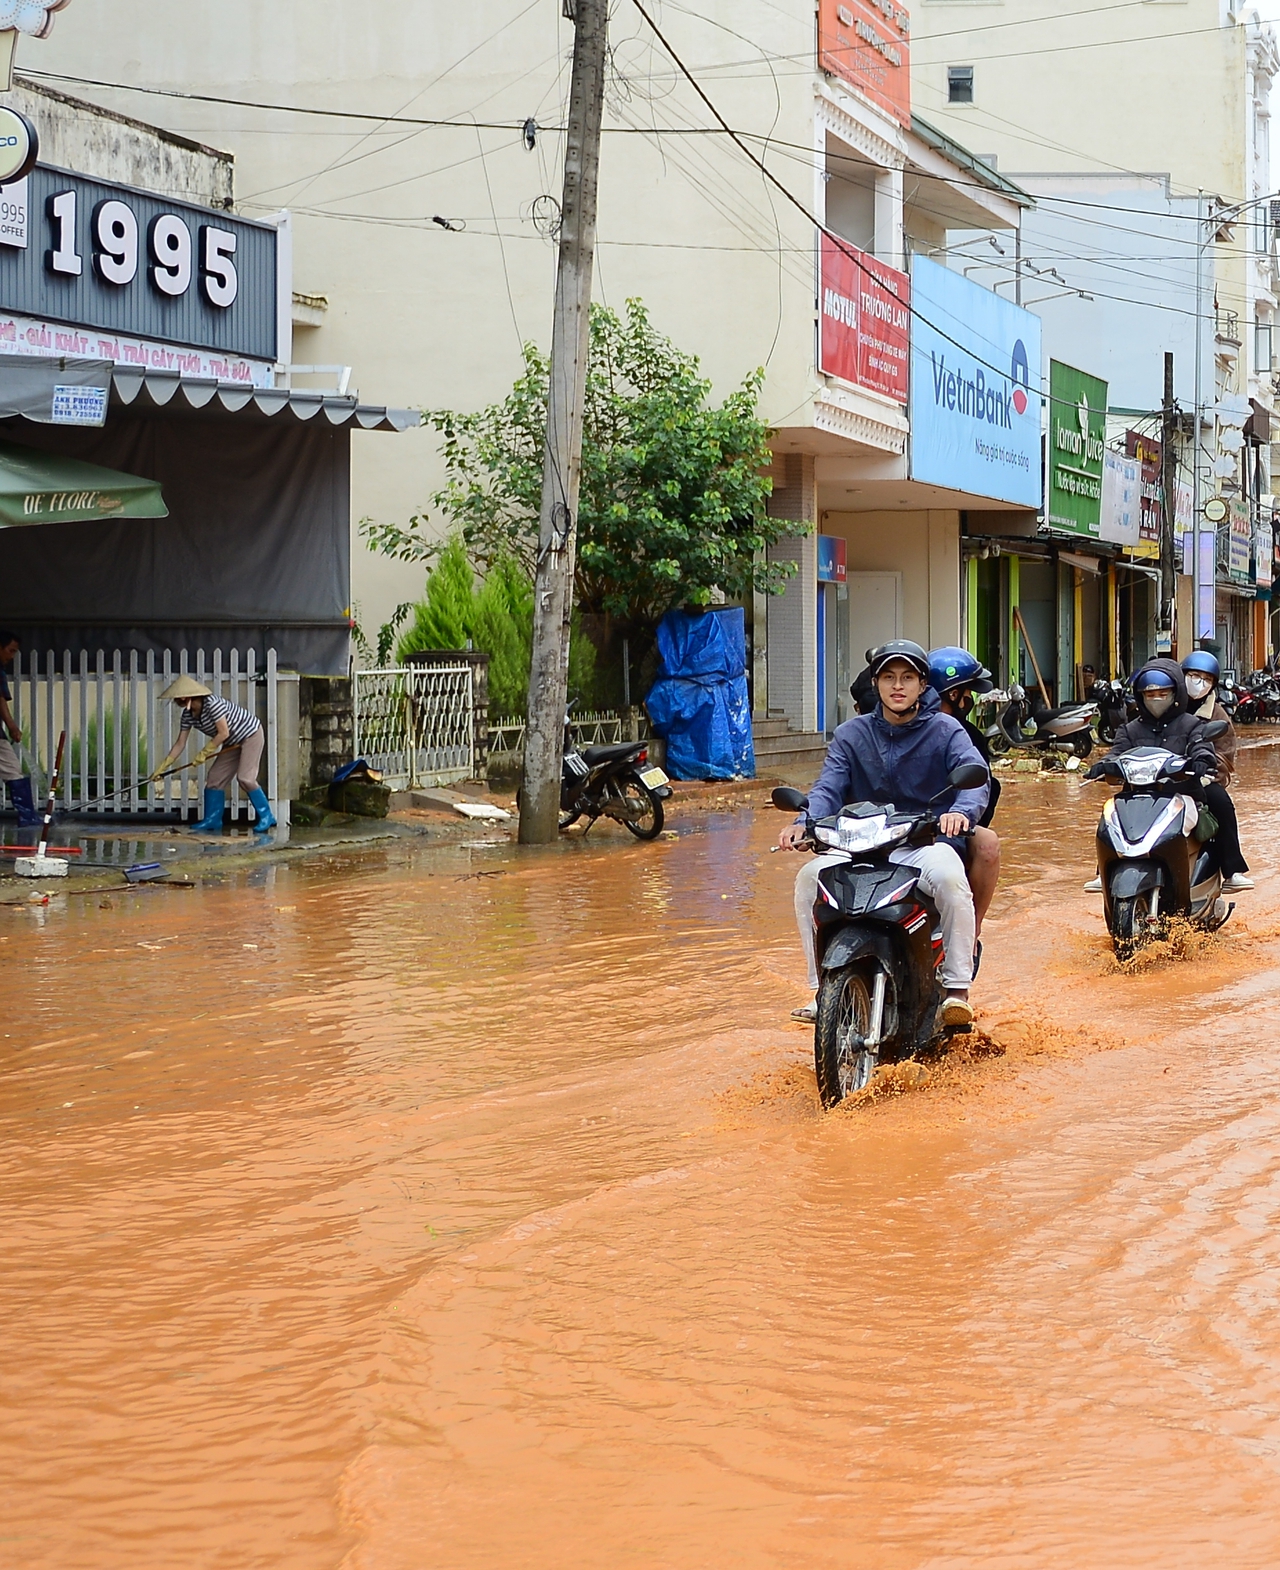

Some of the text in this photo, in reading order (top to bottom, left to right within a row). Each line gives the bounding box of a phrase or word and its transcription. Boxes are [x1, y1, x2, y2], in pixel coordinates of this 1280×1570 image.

[47, 190, 239, 308] 1995
[823, 288, 858, 330] MOTUL
[892, 308, 907, 331] LAN
[26, 324, 52, 347] GIẢI
[55, 331, 89, 355] KHÁT
[97, 338, 120, 359] TRÀ
[124, 344, 149, 367] TRÁI
[151, 348, 175, 371] CÂY
[931, 350, 1012, 430] VietinBank
[49, 491, 100, 512] FLORE
